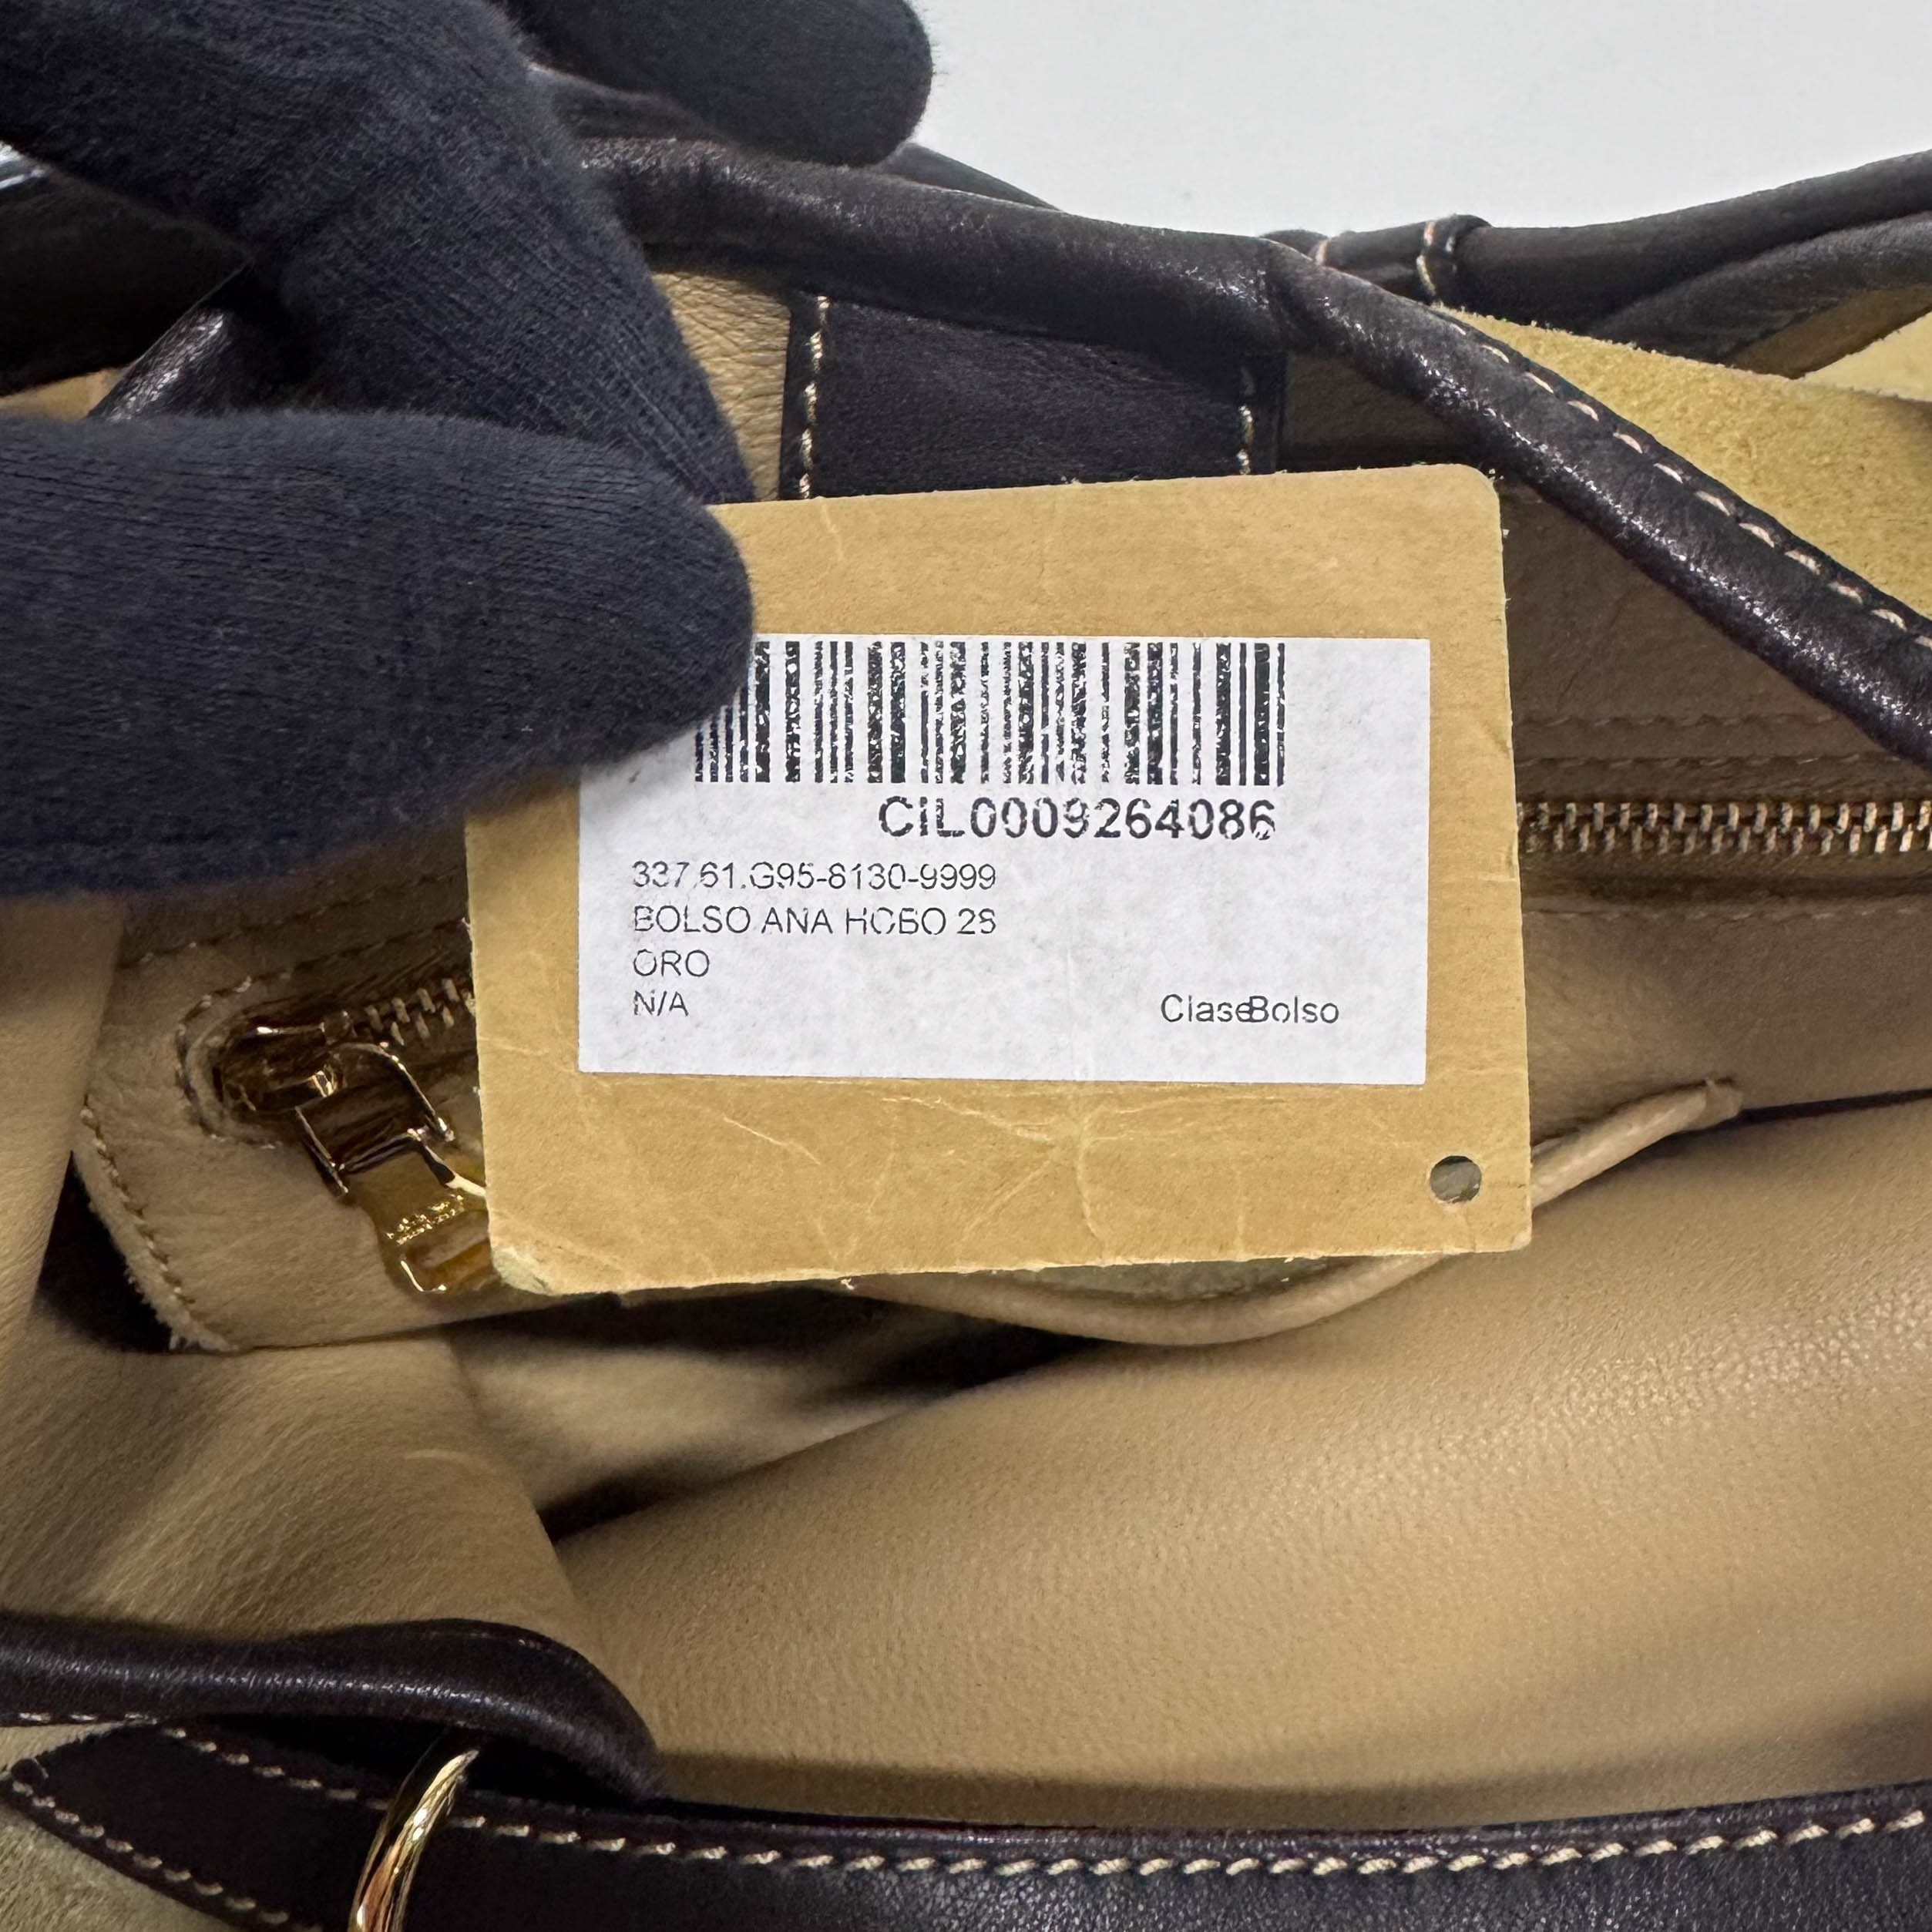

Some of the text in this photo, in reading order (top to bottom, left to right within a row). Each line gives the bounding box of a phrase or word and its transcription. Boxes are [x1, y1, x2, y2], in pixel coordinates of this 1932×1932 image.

[878, 795, 1276, 840] CIL0009264086
[633, 905, 751, 933] BOLSO
[761, 906, 834, 934] ANA
[845, 906, 947, 935] HOBO
[633, 948, 711, 977] ORO
[633, 990, 690, 1017] N/A
